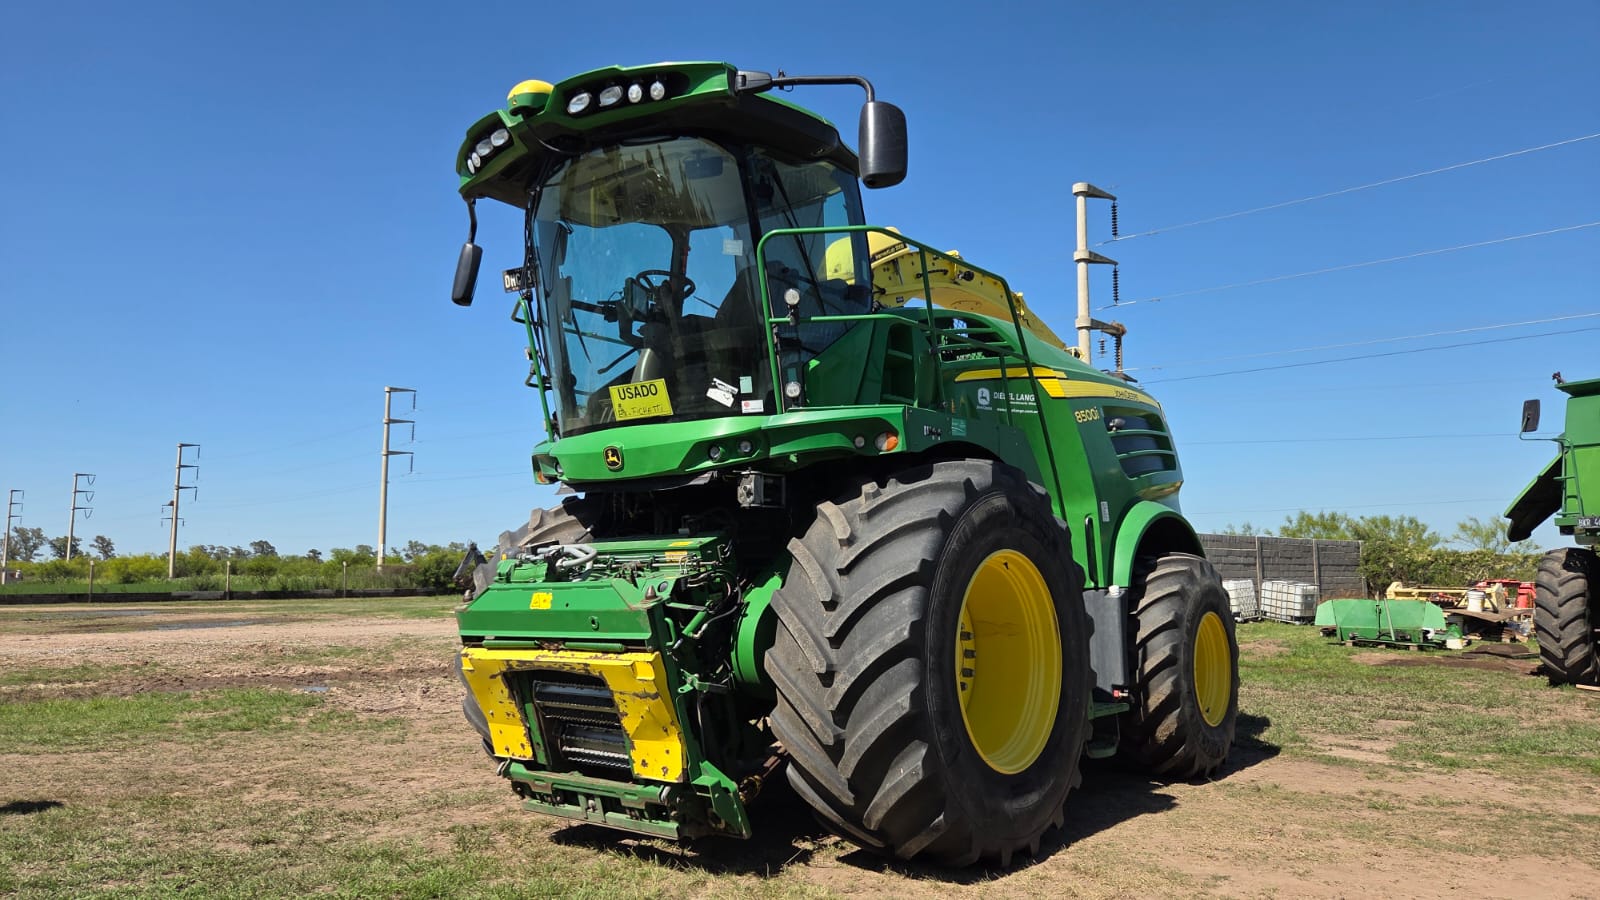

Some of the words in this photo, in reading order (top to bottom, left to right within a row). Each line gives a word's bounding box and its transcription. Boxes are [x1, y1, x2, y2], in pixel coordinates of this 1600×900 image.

[617, 383, 658, 400] USADO
[1016, 393, 1035, 401] LANG
[1074, 406, 1100, 423] 8500i
